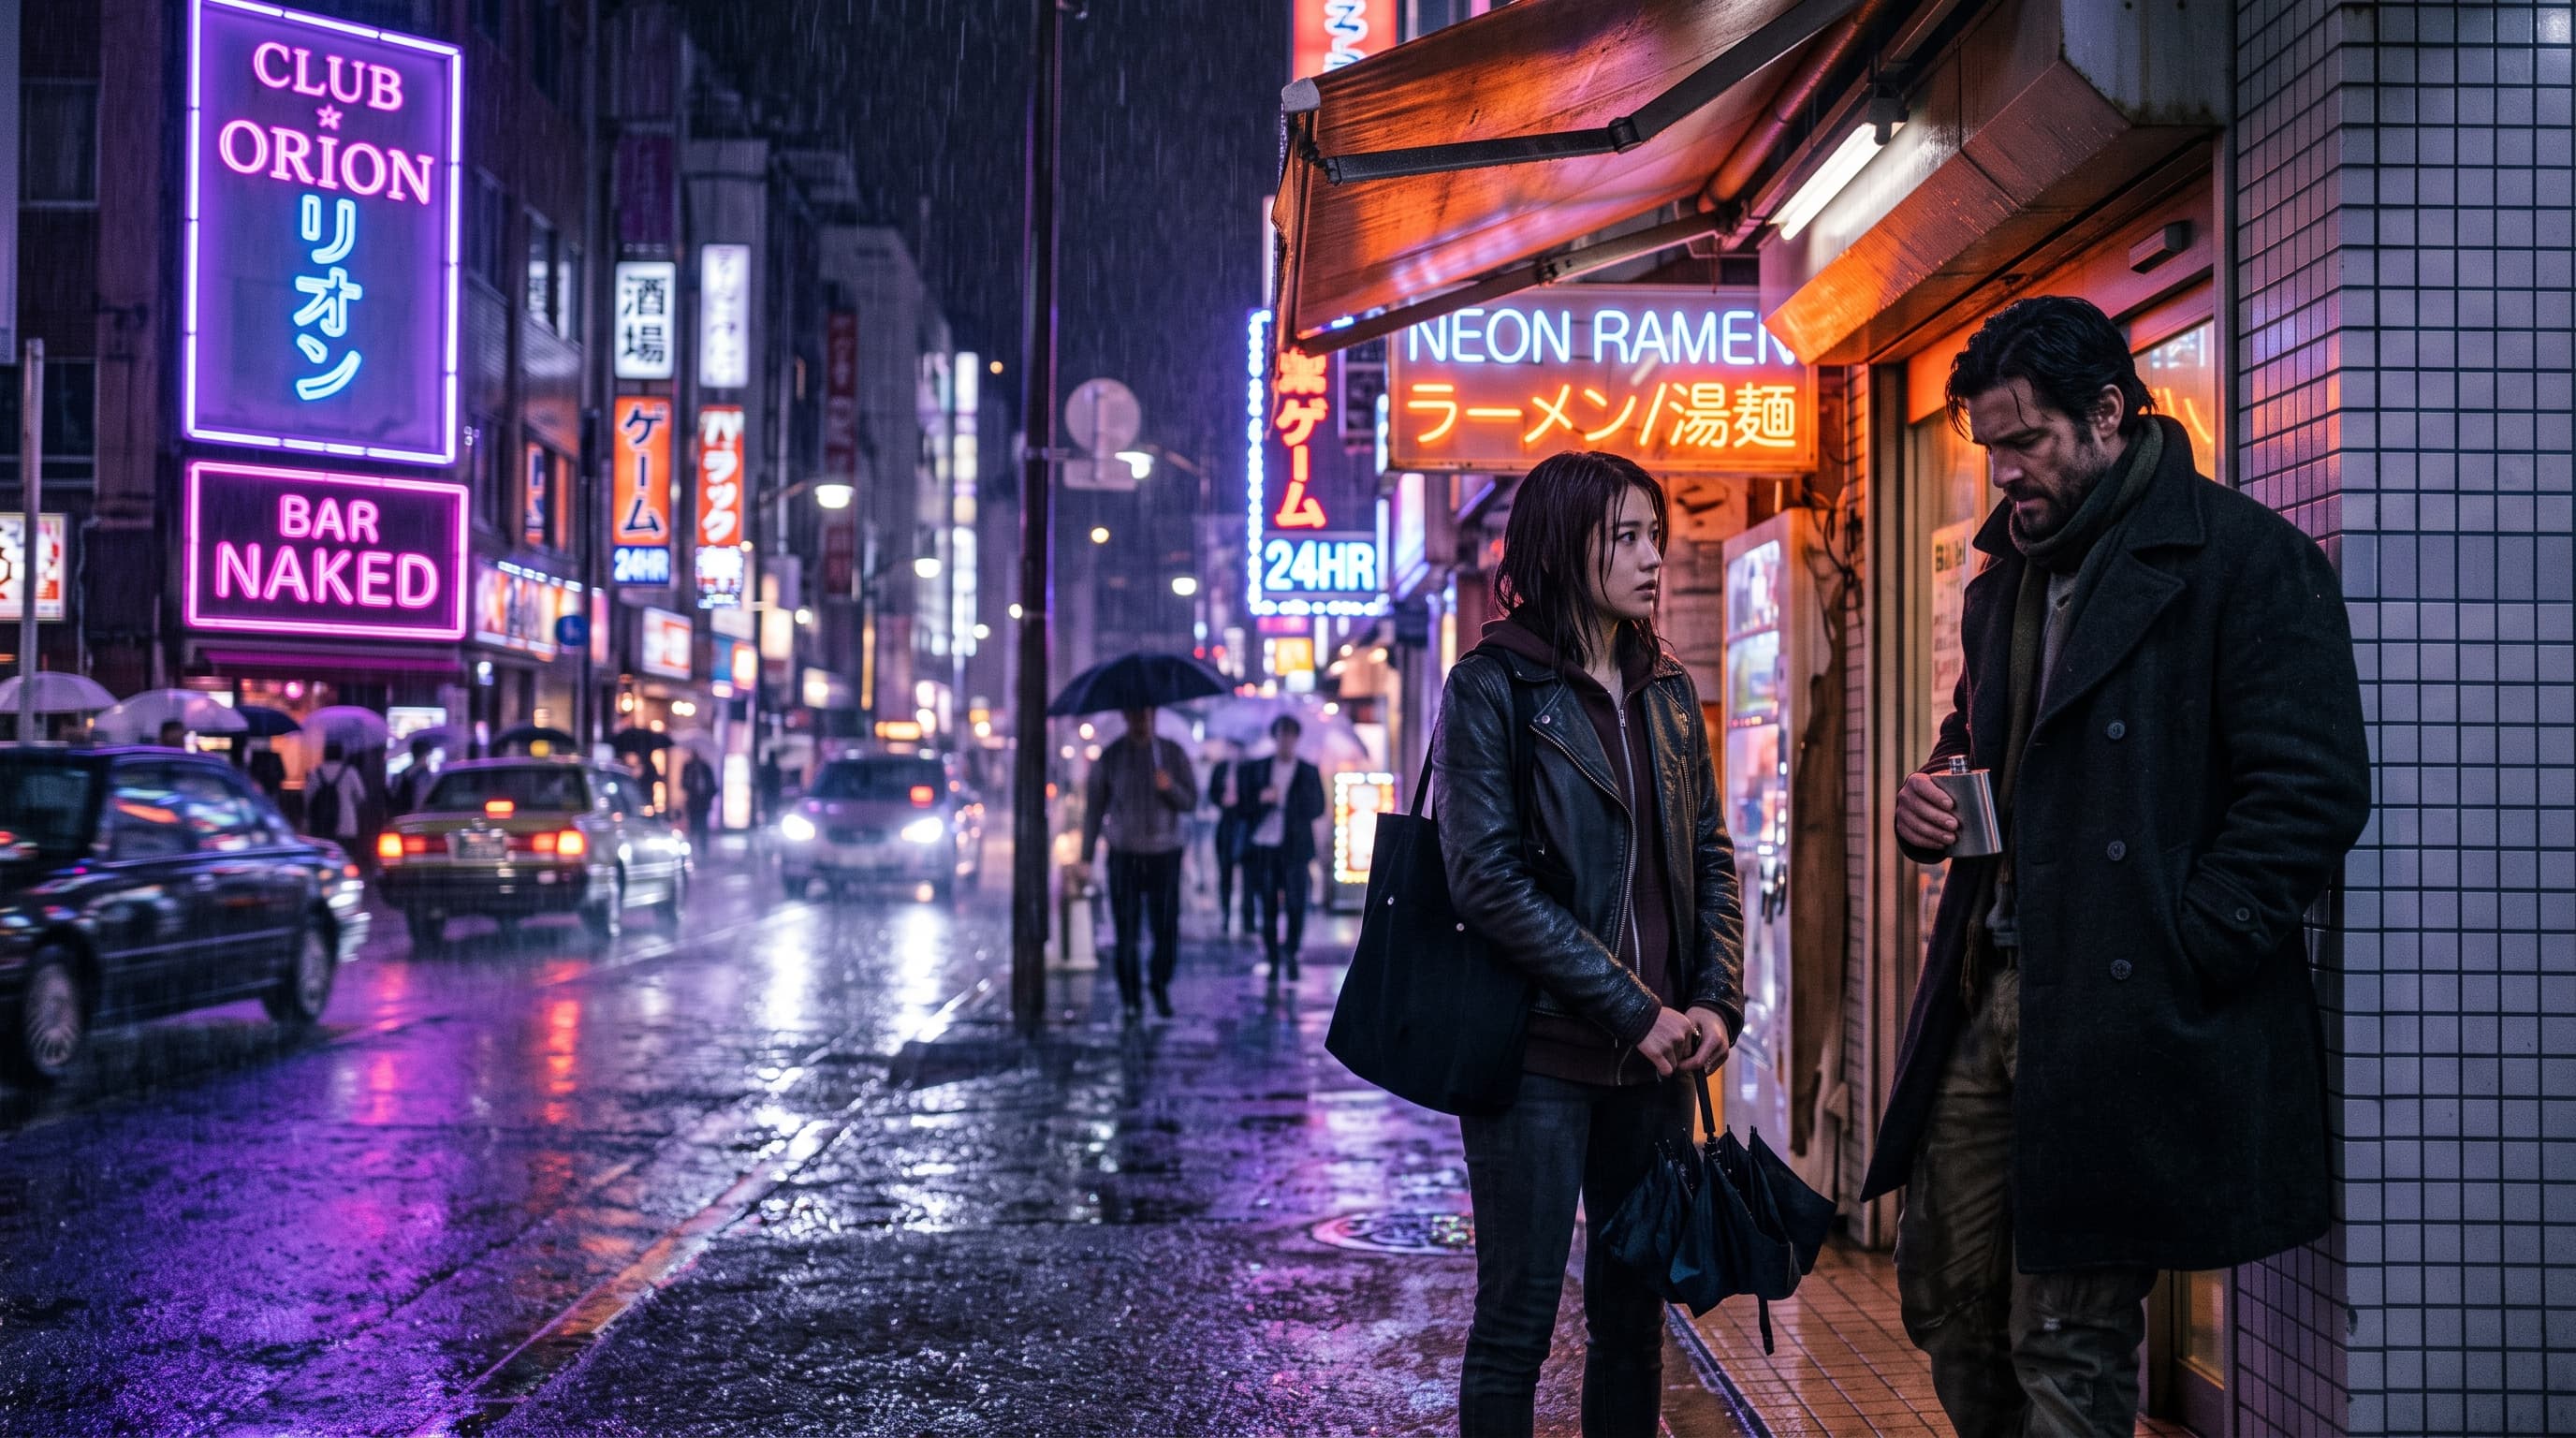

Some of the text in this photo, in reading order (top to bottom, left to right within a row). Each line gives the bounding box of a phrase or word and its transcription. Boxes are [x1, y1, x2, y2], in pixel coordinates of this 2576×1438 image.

[254, 41, 404, 112] CLUB
[218, 119, 435, 205] ORION
[293, 194, 363, 401] リオン
[623, 274, 667, 363] 酒場
[1408, 307, 1572, 364] NEON
[1407, 380, 1797, 448] ラーメン/湯麺
[622, 404, 666, 534] ゲーム
[279, 492, 380, 544] BAR
[214, 540, 440, 609] NAKED
[614, 548, 669, 582] 24HR
[1264, 538, 1376, 592] 24HR
